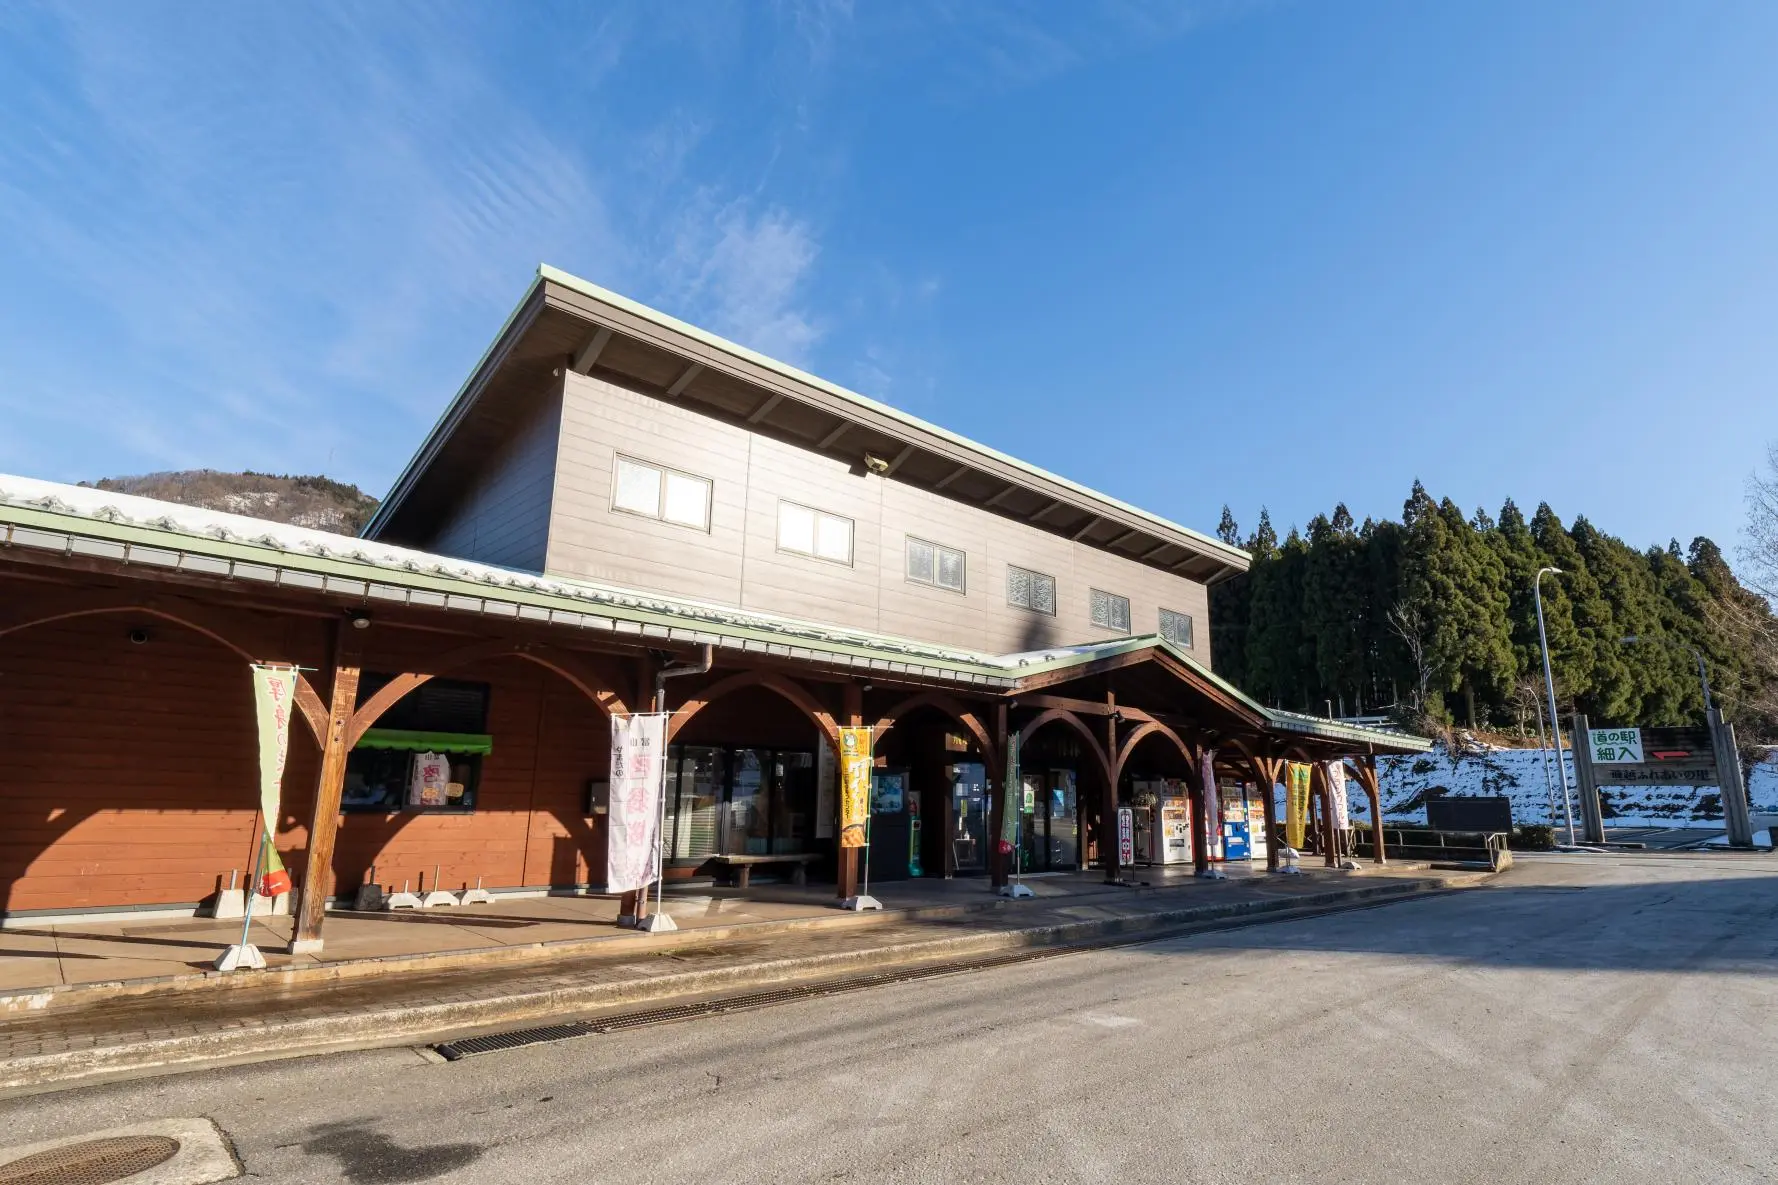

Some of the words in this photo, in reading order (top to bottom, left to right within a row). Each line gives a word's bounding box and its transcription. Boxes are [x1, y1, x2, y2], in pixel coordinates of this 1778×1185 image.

[1593, 730, 1637, 746] 道の駅
[1596, 746, 1638, 761] 細入
